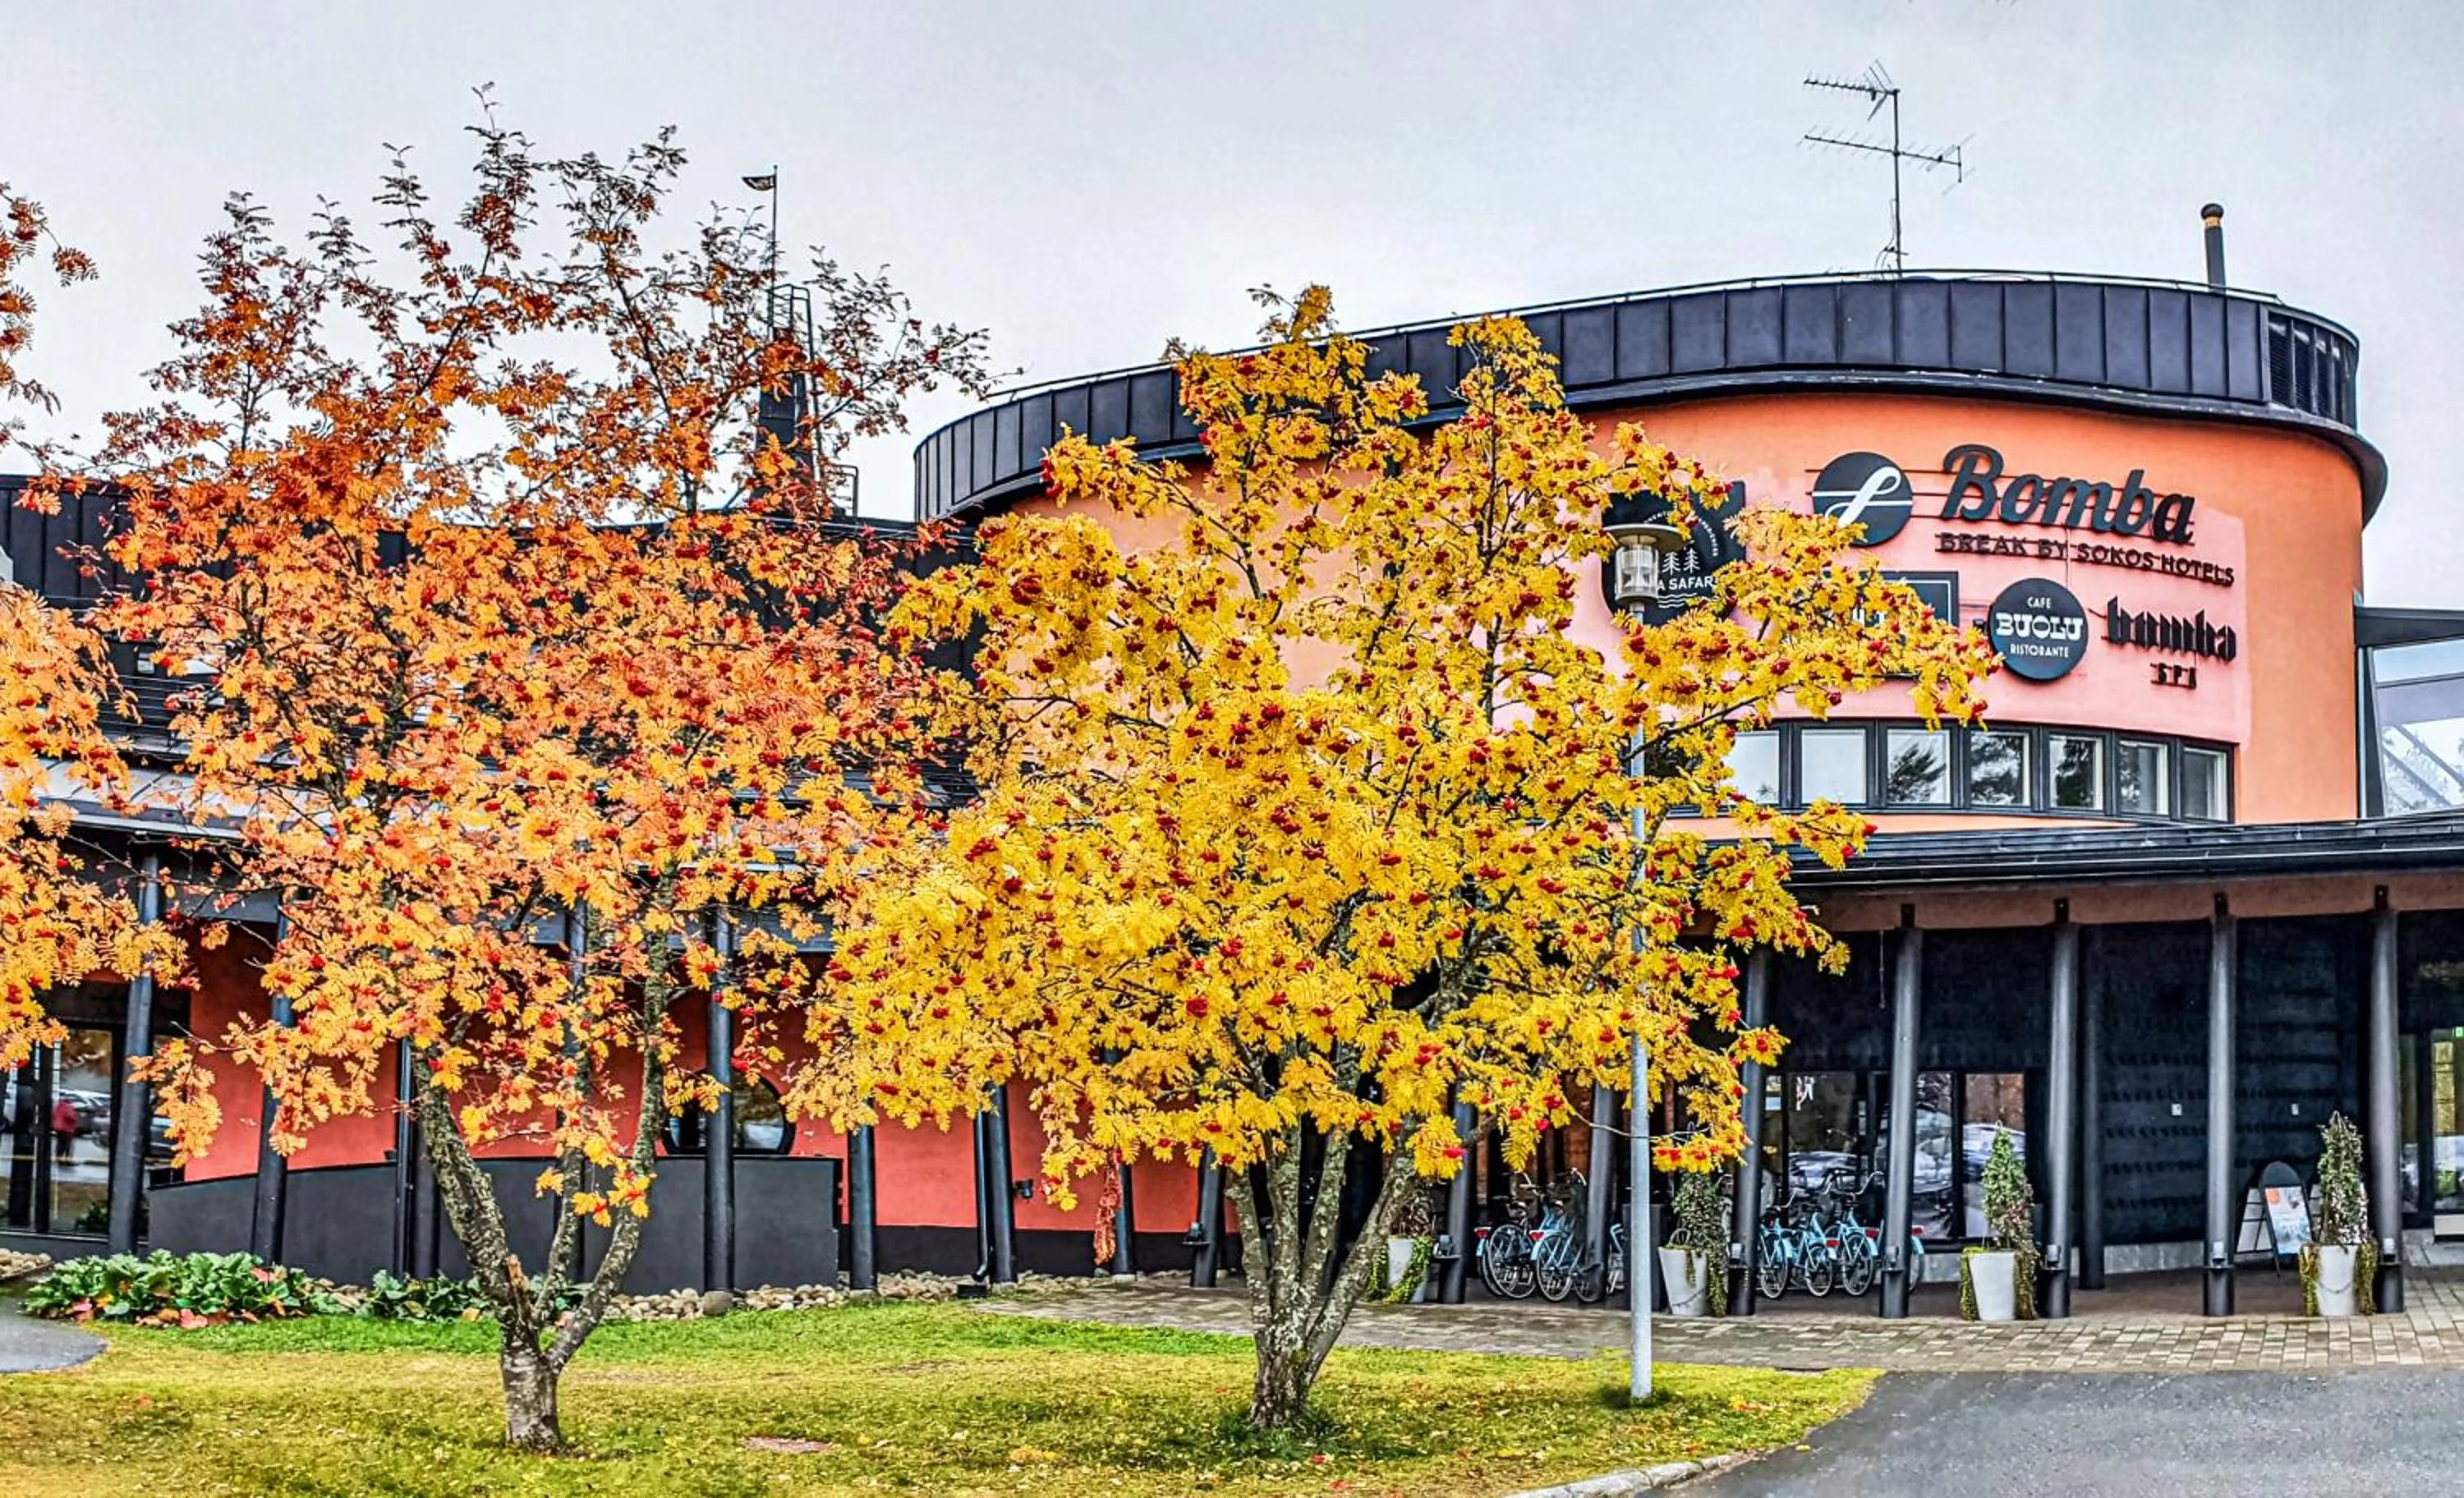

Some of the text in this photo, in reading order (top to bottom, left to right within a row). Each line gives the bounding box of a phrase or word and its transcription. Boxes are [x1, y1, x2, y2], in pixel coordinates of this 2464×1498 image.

[1942, 443, 2195, 544] Bomba
[1940, 531, 2235, 587] BREAK BY SOKOS HOTELS
[1995, 612, 2084, 641] BUOLU
[2010, 643, 2069, 658] RISTORANTE
[2158, 662, 2196, 690] SPA
